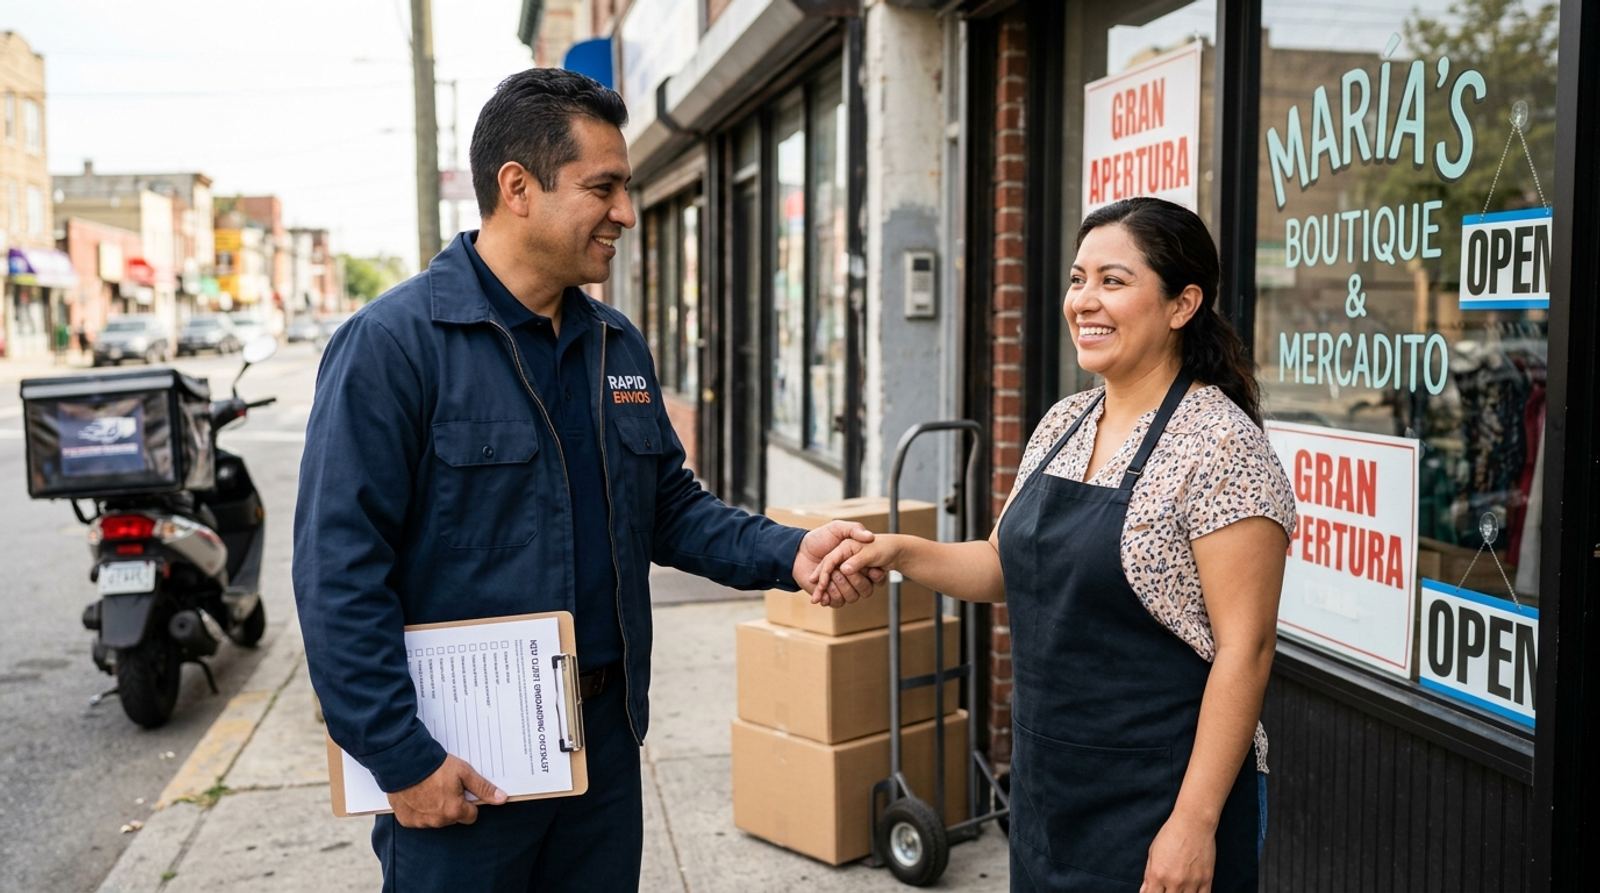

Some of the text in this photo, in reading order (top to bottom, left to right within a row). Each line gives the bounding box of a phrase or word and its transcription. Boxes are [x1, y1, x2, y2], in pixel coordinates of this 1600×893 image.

[1112, 77, 1165, 140] GRAN
[1089, 136, 1189, 205] APERTURA
[1285, 200, 1443, 269] BOUTIQUE
[1467, 225, 1551, 296] OPEN
[1345, 273, 1367, 319] &
[607, 375, 647, 390] RAPID
[1279, 332, 1448, 396] MERCADITO
[613, 391, 651, 404] ENVIOS
[1294, 448, 1377, 518] GRAN
[1428, 599, 1537, 710] OPEN
